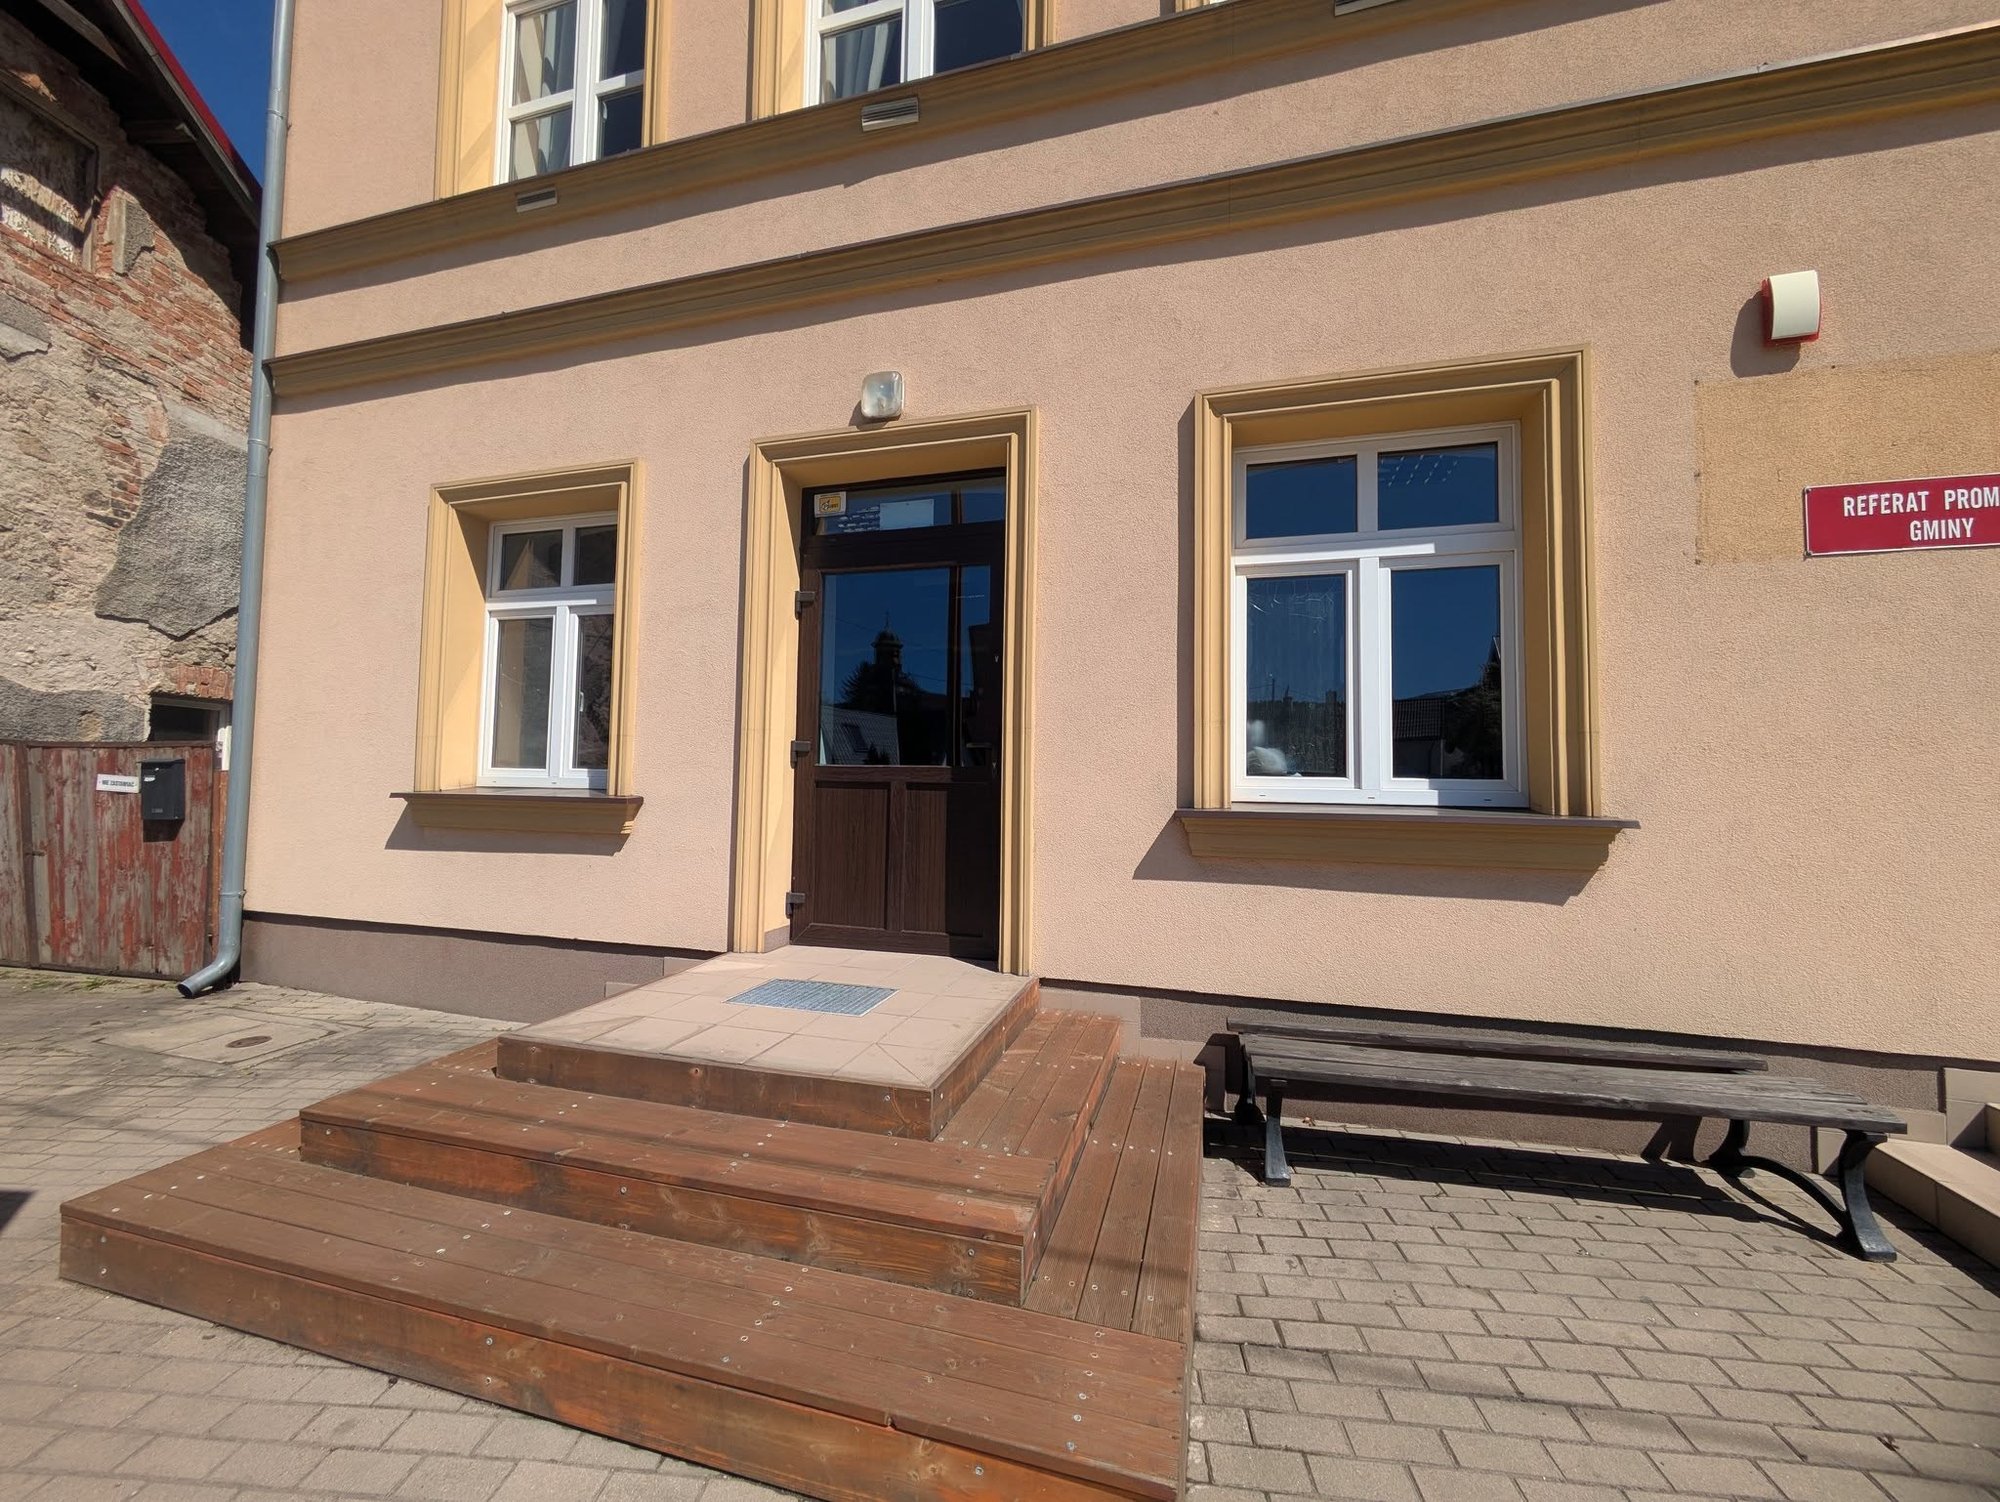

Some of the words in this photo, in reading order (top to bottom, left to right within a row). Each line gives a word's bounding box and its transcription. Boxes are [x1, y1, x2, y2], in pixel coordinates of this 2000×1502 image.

[1843, 491, 1929, 517] REFERAT
[1944, 486, 2000, 510] PROM
[1910, 518, 1974, 541] GMINY
